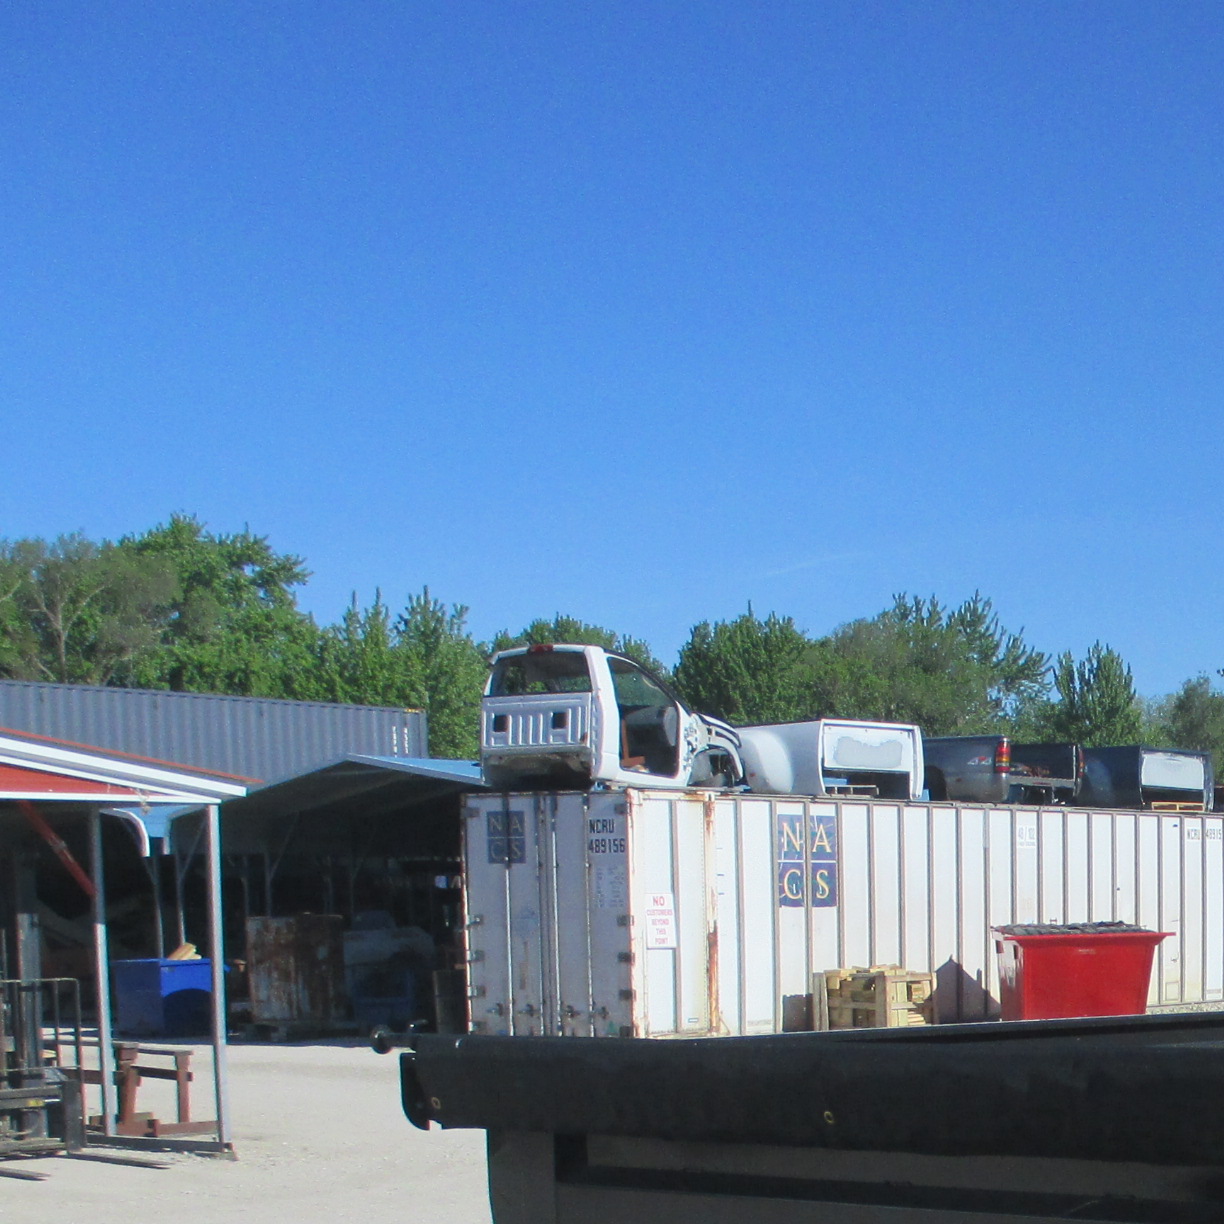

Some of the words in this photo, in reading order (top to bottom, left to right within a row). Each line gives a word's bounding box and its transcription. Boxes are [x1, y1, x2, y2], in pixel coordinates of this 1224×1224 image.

[589, 818, 615, 834] NCRU
[589, 838, 625, 854] 489156
[652, 895, 666, 907] NO
[651, 918, 670, 926] BEYOND
